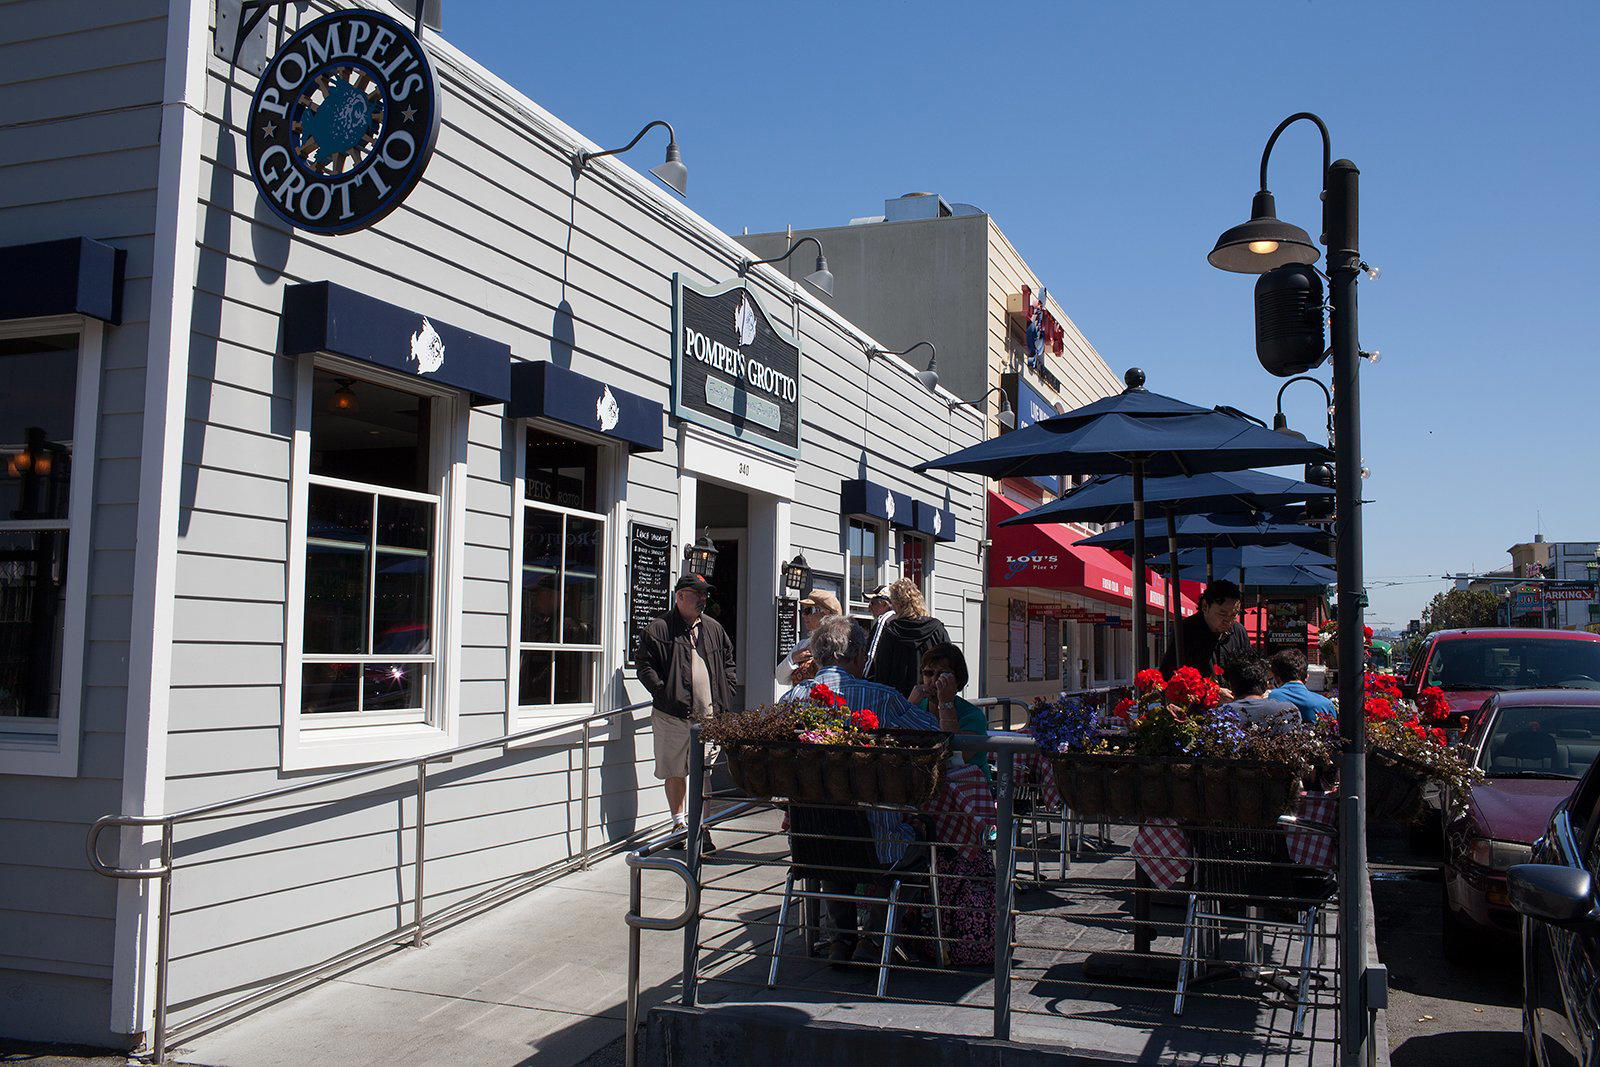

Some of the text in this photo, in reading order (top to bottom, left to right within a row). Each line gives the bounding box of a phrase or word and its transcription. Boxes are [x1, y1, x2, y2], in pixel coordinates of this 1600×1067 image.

[258, 20, 424, 119] POMPEI'S
[259, 130, 415, 220] GROTTO
[685, 327, 745, 379] POMPEI'S
[748, 358, 797, 403] GROTTO
[739, 463, 750, 476] 340
[1006, 555, 1058, 563] LOU'S
[1539, 591, 1582, 599] PARKING
